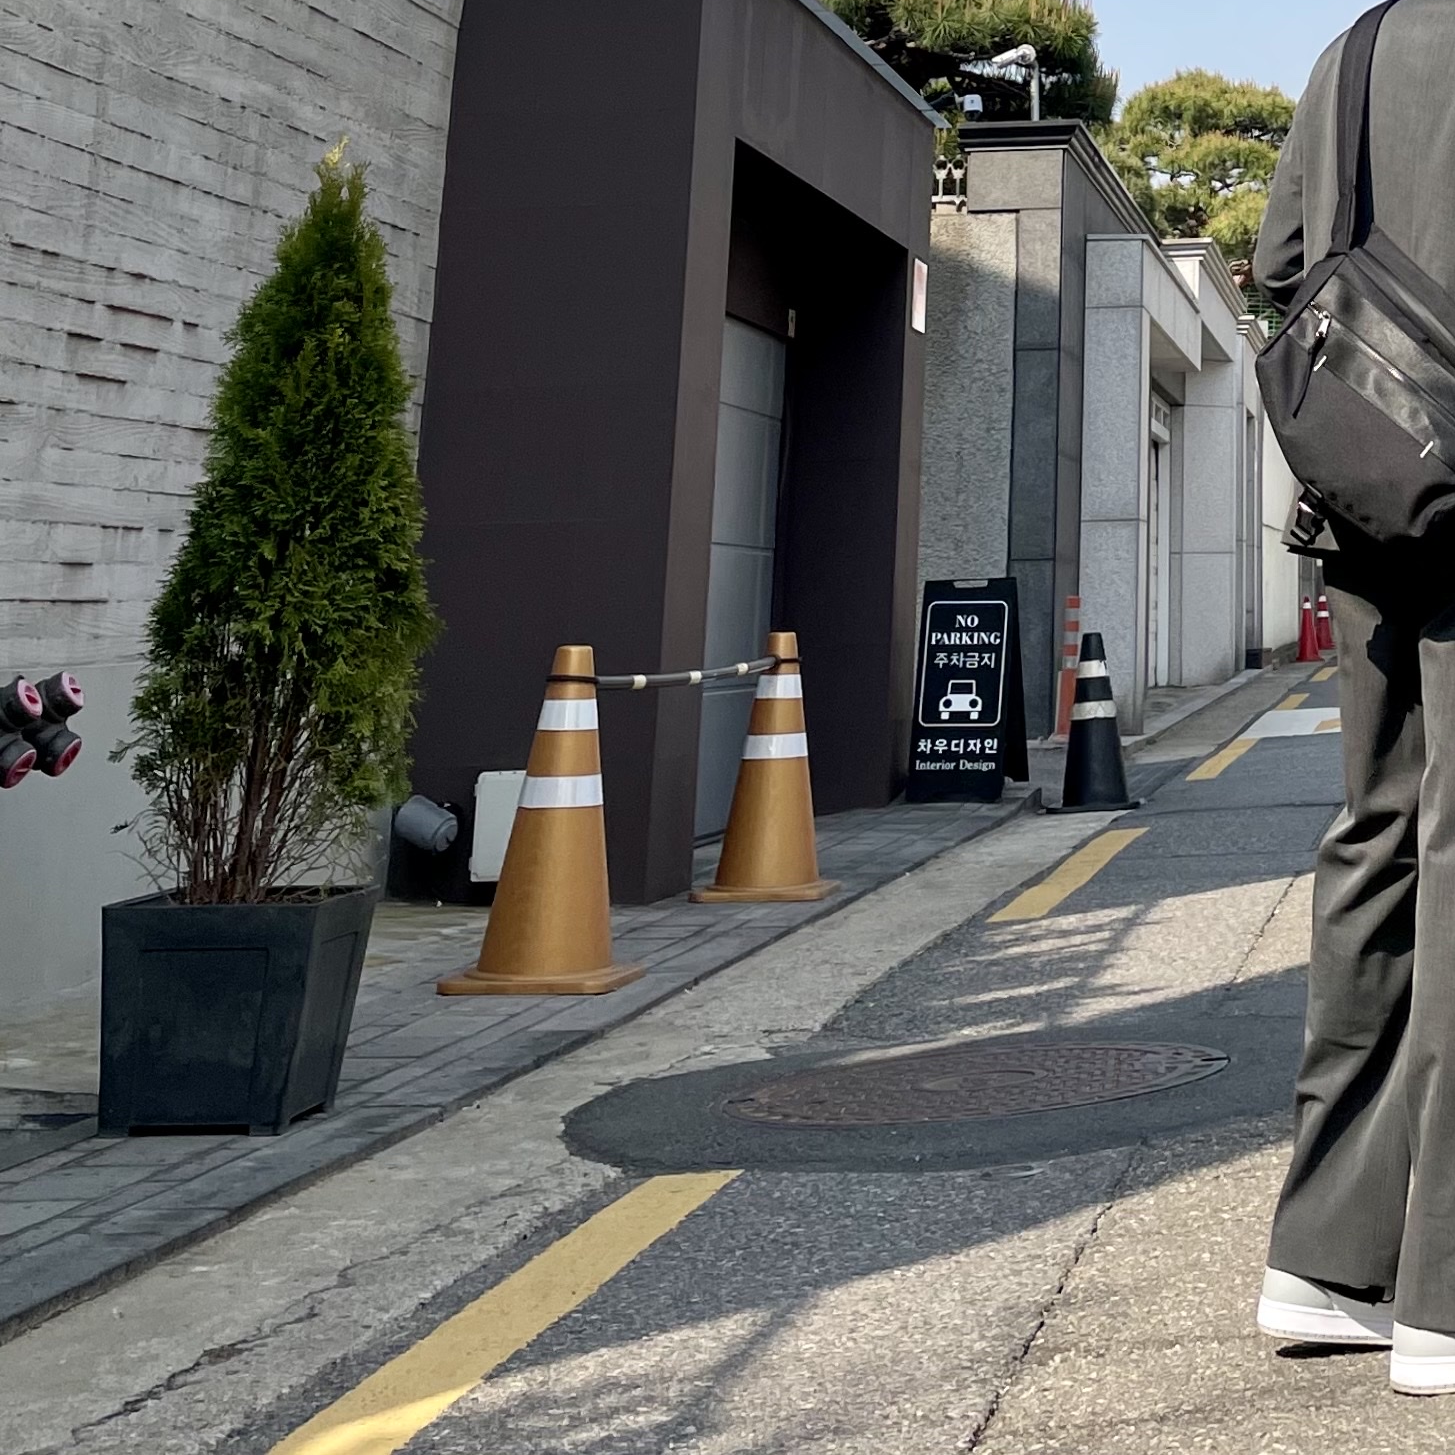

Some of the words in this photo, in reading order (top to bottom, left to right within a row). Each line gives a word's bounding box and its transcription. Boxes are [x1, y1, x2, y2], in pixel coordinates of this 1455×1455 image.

[955, 614, 979, 628] NO
[930, 631, 1001, 645] PARKING
[933, 652, 996, 669] 주차금지
[916, 738, 998, 754] 차우디자인
[915, 759, 956, 771] Interior
[959, 759, 996, 772] Design
